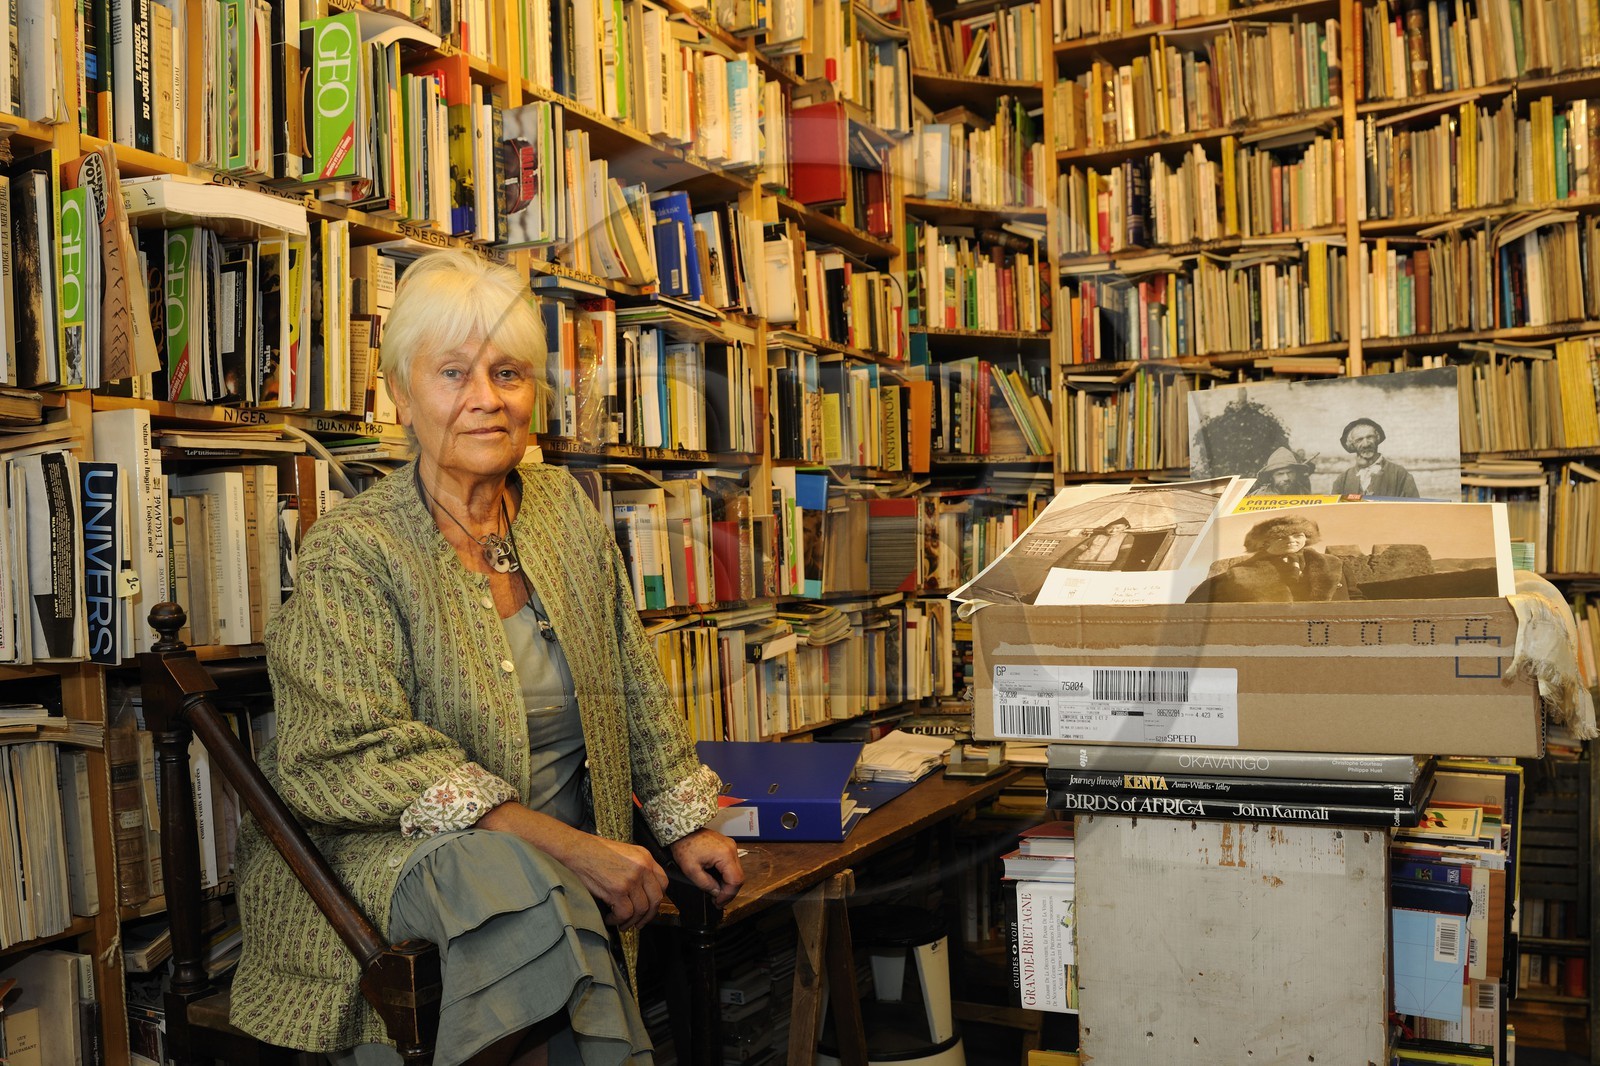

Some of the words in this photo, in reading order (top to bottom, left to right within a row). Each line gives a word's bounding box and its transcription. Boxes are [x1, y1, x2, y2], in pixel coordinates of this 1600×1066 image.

[140, 21, 148, 38] LA
[134, 22, 143, 81] L'AFRIQUE
[141, 39, 148, 54] DE
[141, 53, 149, 70] ET
[317, 22, 352, 118] GEO
[142, 70, 150, 102] JOUR
[142, 102, 150, 120] DU
[0, 212, 8, 228] MER
[396, 223, 453, 247] SENEGAL
[464, 241, 505, 260] GAMBIE
[61, 199, 82, 318] GEO
[168, 233, 188, 337] GEO
[148, 267, 164, 366] ORSTO
[263, 344, 271, 374] Peuls
[223, 410, 270, 425] NIGER
[316, 419, 362, 432] BURKINA
[365, 423, 384, 435] FASO
[885, 390, 897, 470] MONUMENTA
[143, 467, 151, 494] Huggins
[318, 490, 327, 516] Bénin
[145, 505, 153, 535] L'odyssée
[85, 470, 114, 657] UNIVERS
[1061, 681, 1084, 692] 75004
[912, 726, 961, 736] GUIDES
[1167, 735, 1197, 743] SPEED
[1079, 748, 1088, 768] vilo
[1178, 754, 1270, 771] OKAVANGO
[1331, 760, 1359, 768] Christophe
[1360, 760, 1383, 768] Courteau
[1068, 774, 1096, 787] Journey
[1096, 775, 1123, 788] through
[1123, 774, 1169, 791] KENYA
[1393, 786, 1405, 801] BH
[1065, 793, 1120, 812] BIRDS
[1120, 796, 1138, 812] of
[1138, 797, 1206, 816] AFRICA
[1232, 803, 1271, 817] John
[1271, 804, 1330, 821] Karmali
[1010, 921, 1018, 943] VOIR
[1021, 892, 1037, 1006] GRANDE-BRETAGNE
[1012, 956, 1020, 989] GUIDES
